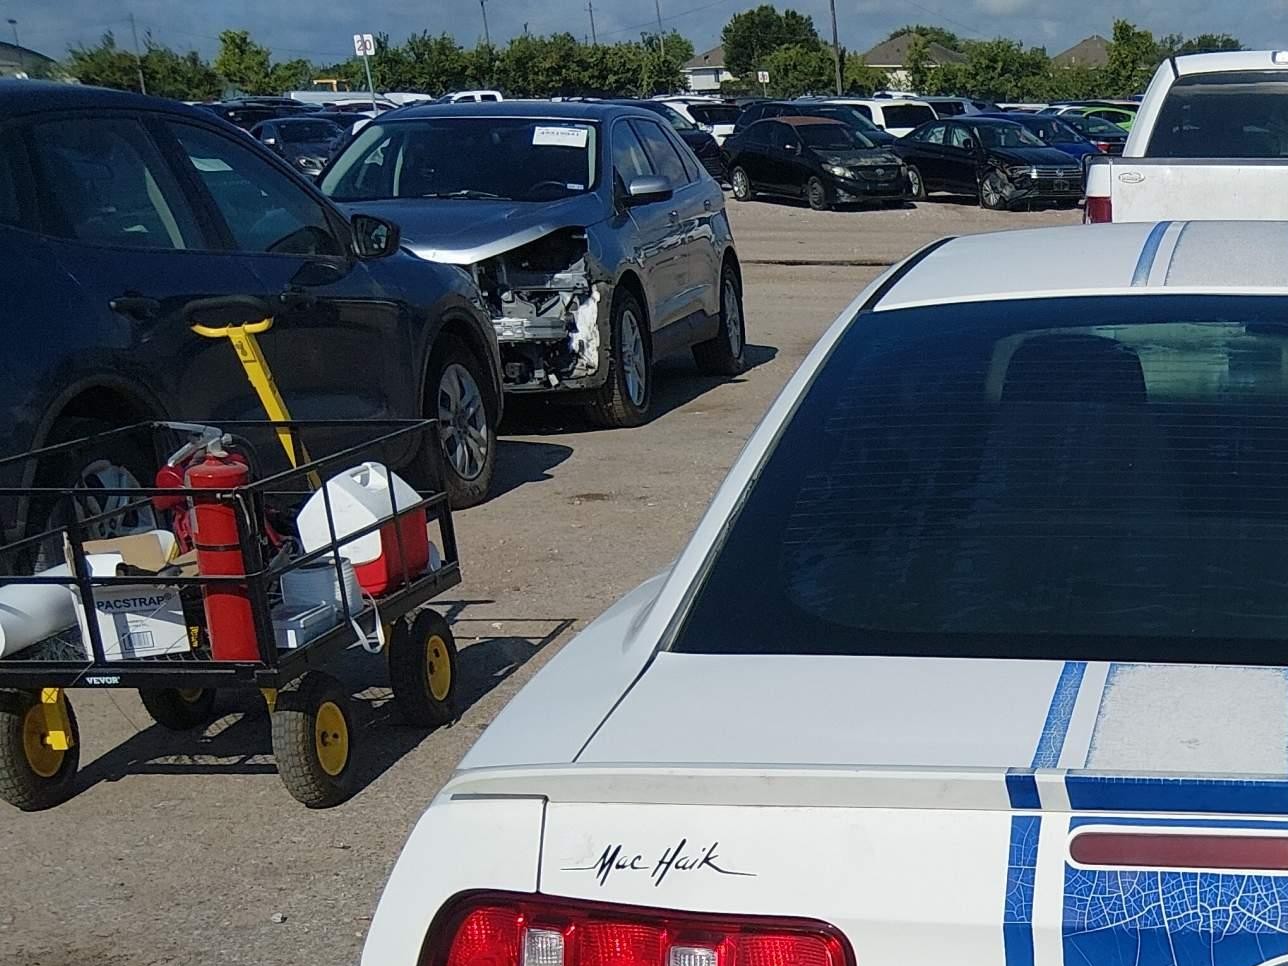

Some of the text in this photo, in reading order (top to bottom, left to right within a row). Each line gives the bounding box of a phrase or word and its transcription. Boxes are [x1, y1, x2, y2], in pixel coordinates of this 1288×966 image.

[356, 39, 372, 52] 20
[560, 838, 757, 886] Mac Haik
